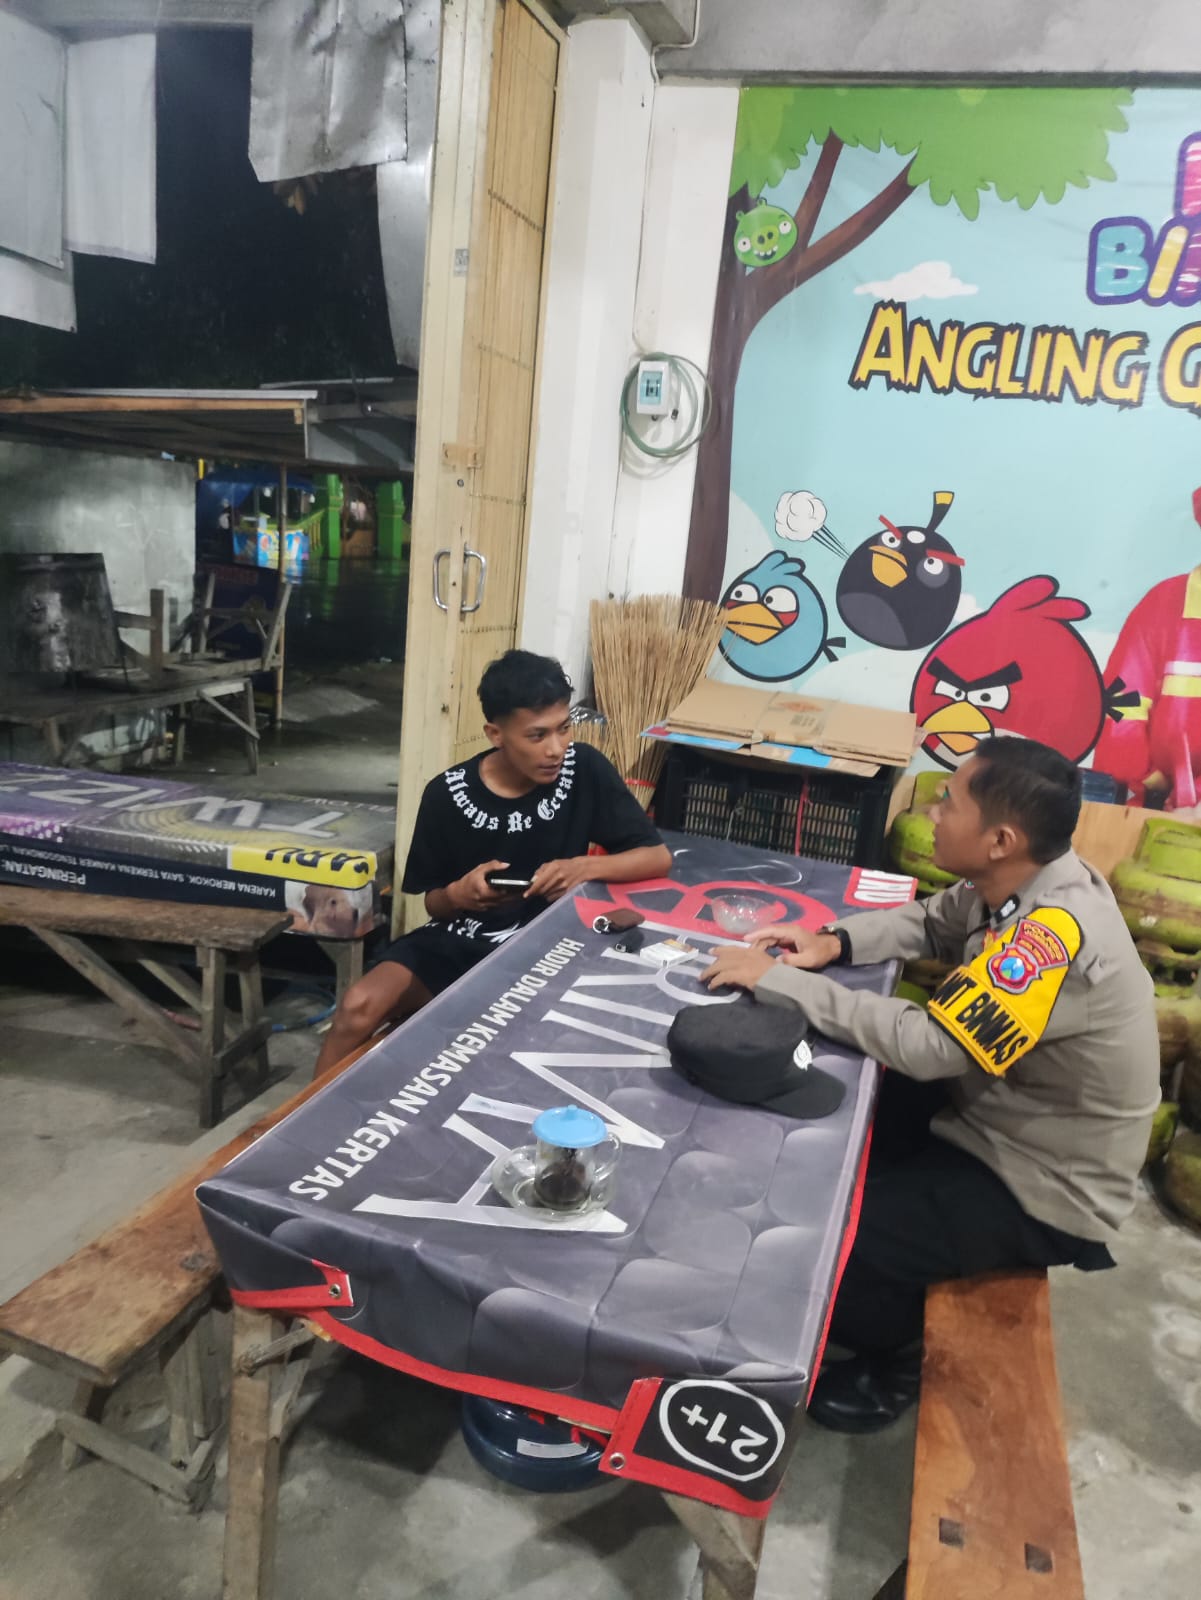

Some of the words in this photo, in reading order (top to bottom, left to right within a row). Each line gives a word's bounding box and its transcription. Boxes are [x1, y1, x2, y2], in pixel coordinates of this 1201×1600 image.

[848, 299, 1150, 412] ANGLING
[445, 768, 499, 830] Always
[507, 811, 533, 834] Be
[537, 741, 576, 821] Creativ
[118, 863, 160, 879] TERKENA
[160, 871, 185, 883] SAYA
[238, 882, 276, 898] KARENA
[531, 938, 584, 977] HADIR
[488, 976, 548, 1027] DALAM
[390, 1021, 499, 1114] KEMASAN
[289, 1111, 407, 1201] KERTAS
[680, 1404, 768, 1463] 21+
